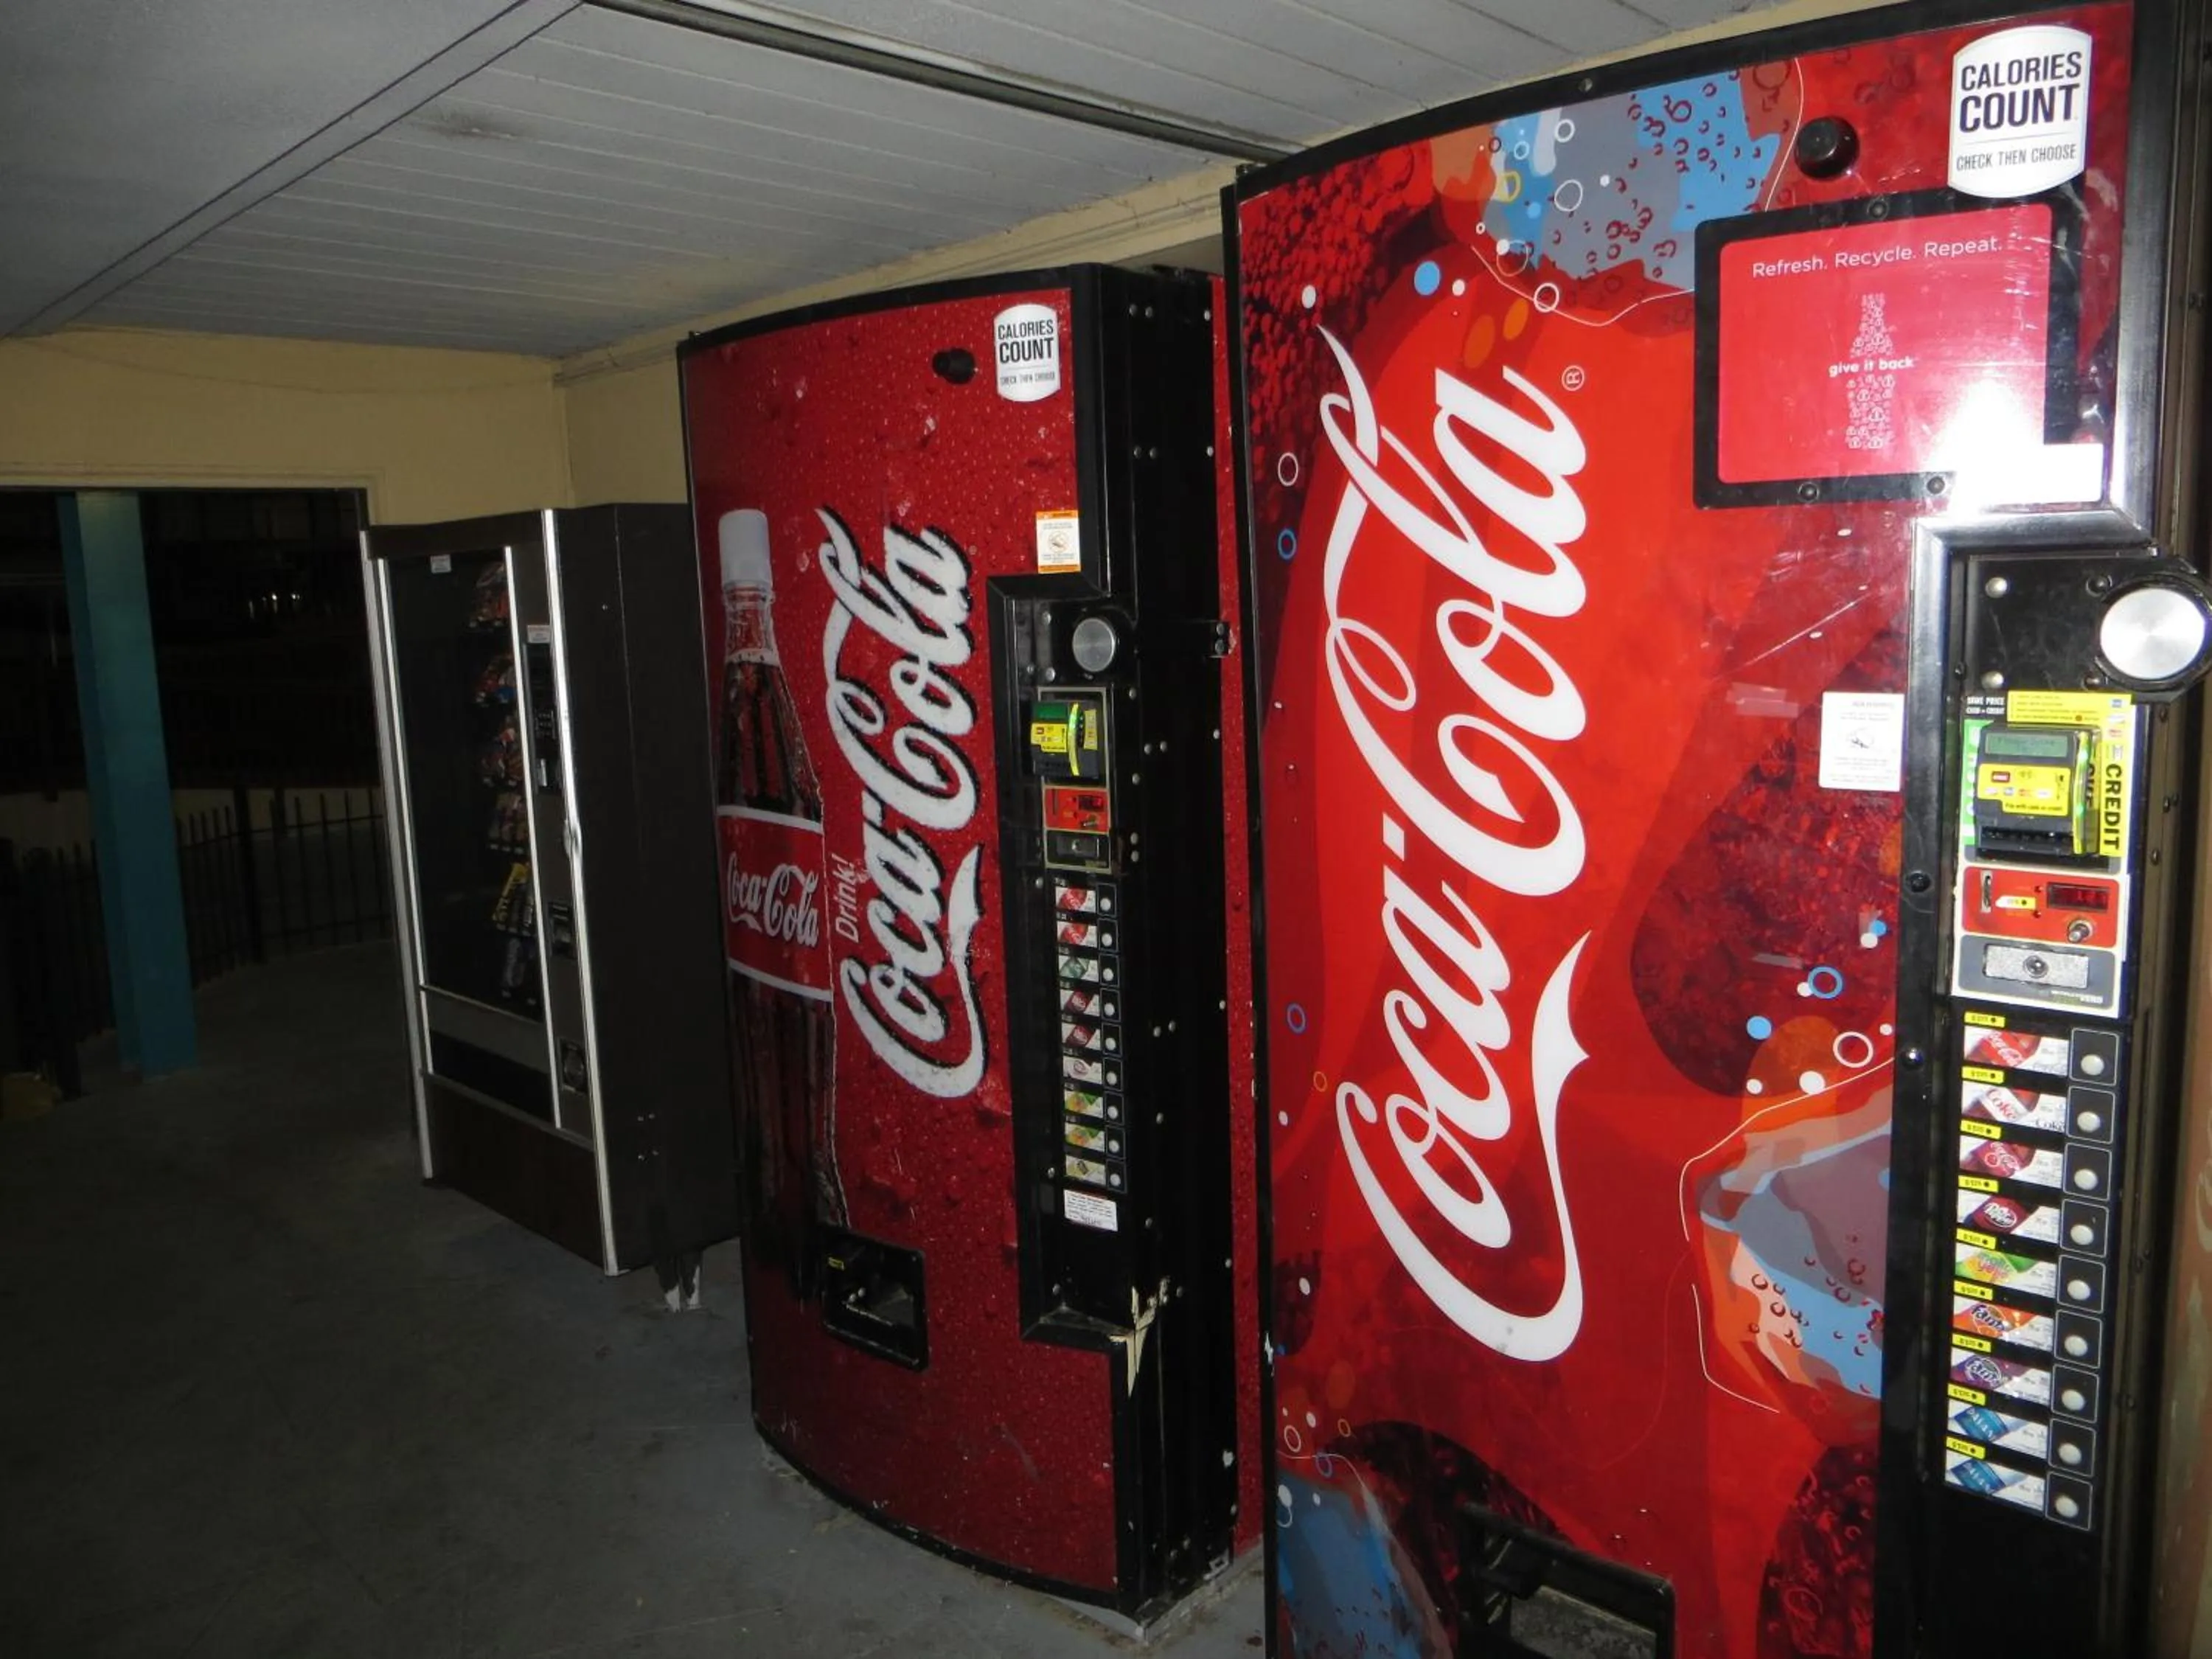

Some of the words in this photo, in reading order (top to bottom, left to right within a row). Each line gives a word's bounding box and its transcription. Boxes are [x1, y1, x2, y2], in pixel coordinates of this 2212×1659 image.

[1961, 51, 2082, 91] CALORIES
[1959, 83, 2080, 133] COUNT
[1956, 153, 1992, 172] CHECK
[1999, 148, 2026, 167] THEN
[2031, 144, 2076, 162] CHOOSE
[1752, 256, 1828, 279] Refresh.
[1834, 245, 1916, 272] Recycle.
[1924, 235, 2003, 261] Repeat.
[998, 319, 1054, 340] CALORIES
[999, 337, 1054, 364] COUNT
[1829, 362, 1860, 378] give
[1864, 358, 1874, 371] it
[1879, 356, 1914, 370] back
[816, 505, 987, 1099] Coca-Cola
[2104, 763, 2122, 849] CREDIT
[1321, 325, 1590, 1362] Coca-Cola
[728, 852, 819, 947] Coca-Cola
[831, 852, 860, 944] Drink!
